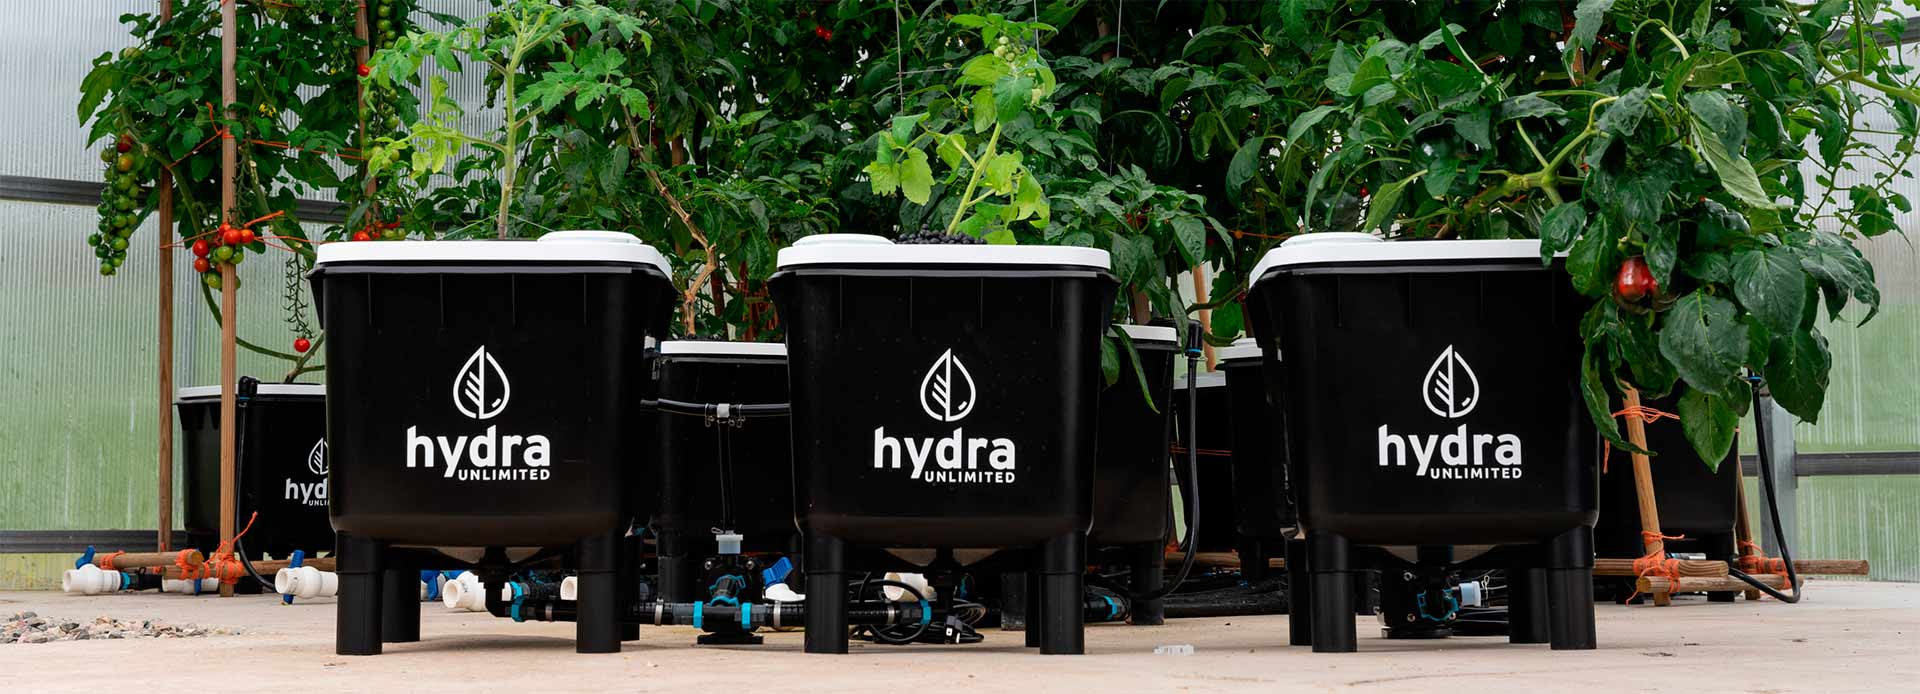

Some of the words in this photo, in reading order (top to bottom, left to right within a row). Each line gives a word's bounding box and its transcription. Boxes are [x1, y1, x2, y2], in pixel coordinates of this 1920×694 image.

[406, 424, 551, 478] hydra
[873, 426, 1016, 479] hydra
[1378, 423, 1522, 476] hydra
[458, 468, 551, 481] UNLIMITED
[924, 470, 1016, 483] UNLIMITED
[1430, 467, 1522, 480] UNLIMITED
